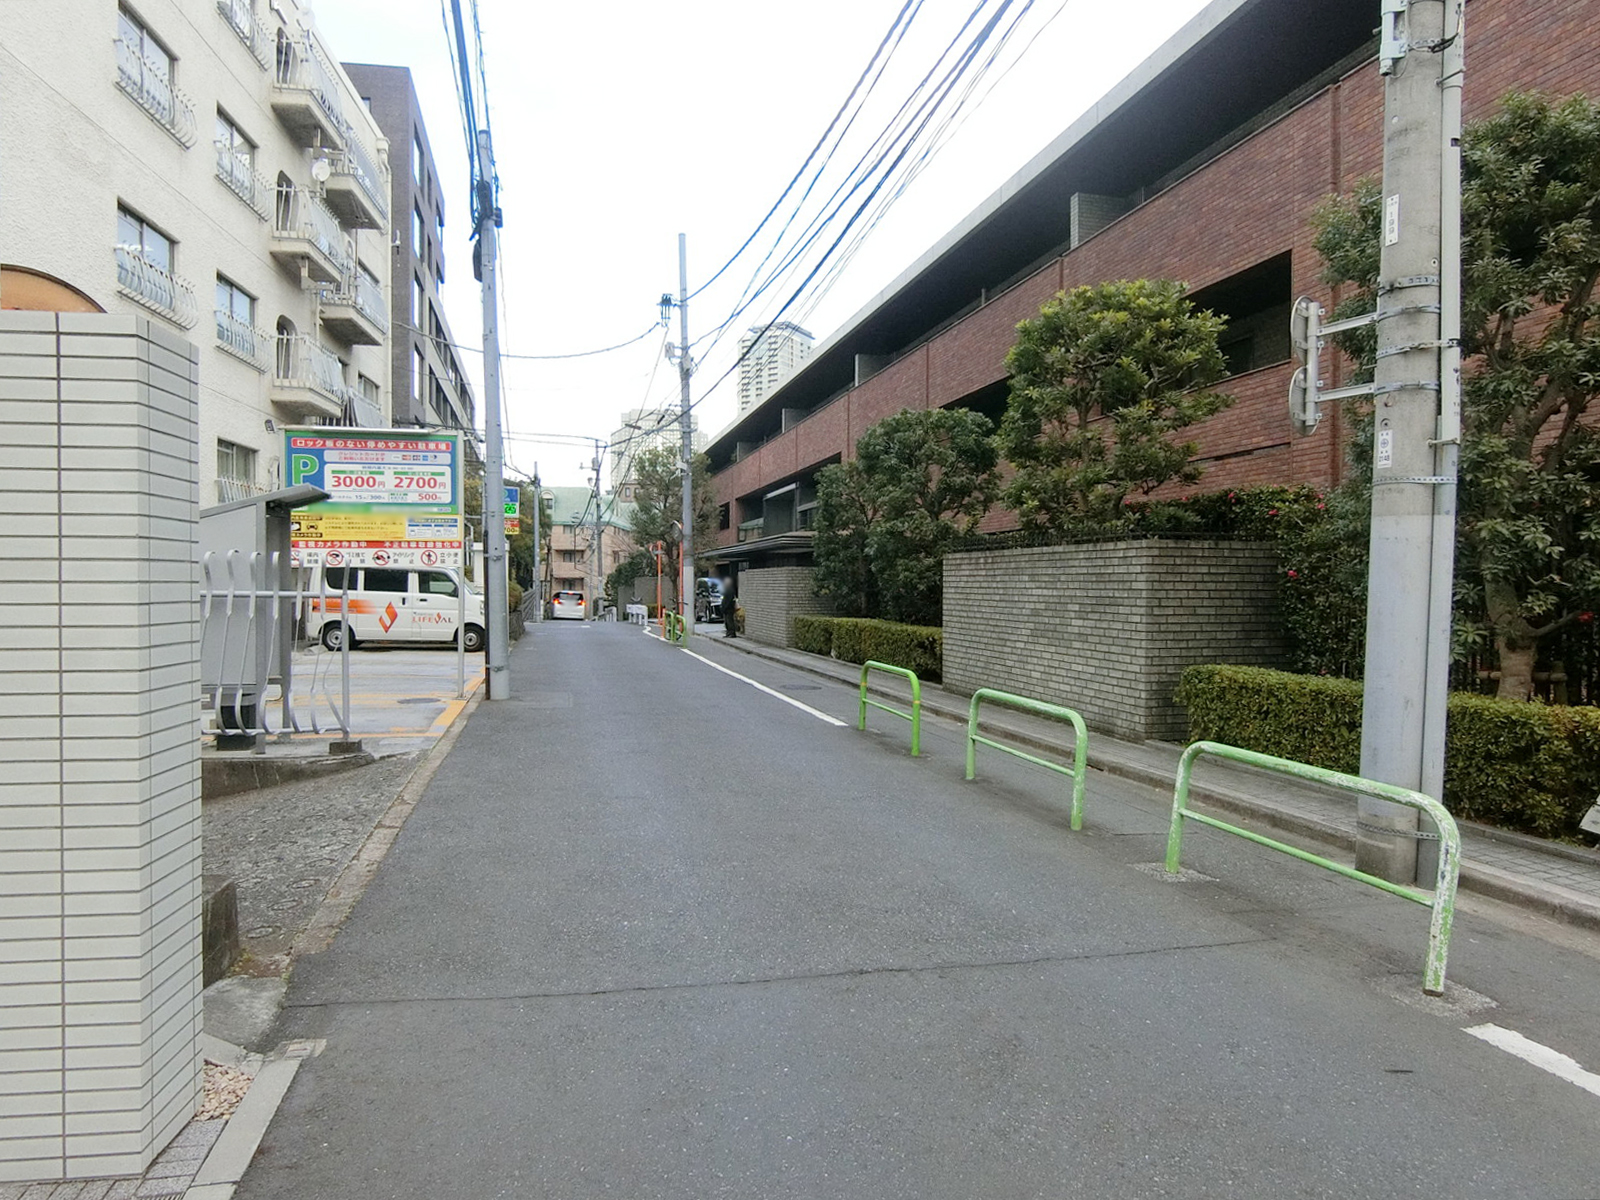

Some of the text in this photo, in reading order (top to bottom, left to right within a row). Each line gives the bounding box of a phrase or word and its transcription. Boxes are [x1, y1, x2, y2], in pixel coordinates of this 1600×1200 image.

[296, 439, 446, 450] ロック板のない停めやすい駐車場
[292, 454, 319, 485] P
[331, 475, 386, 489] 3000円
[394, 476, 446, 489] 2700円
